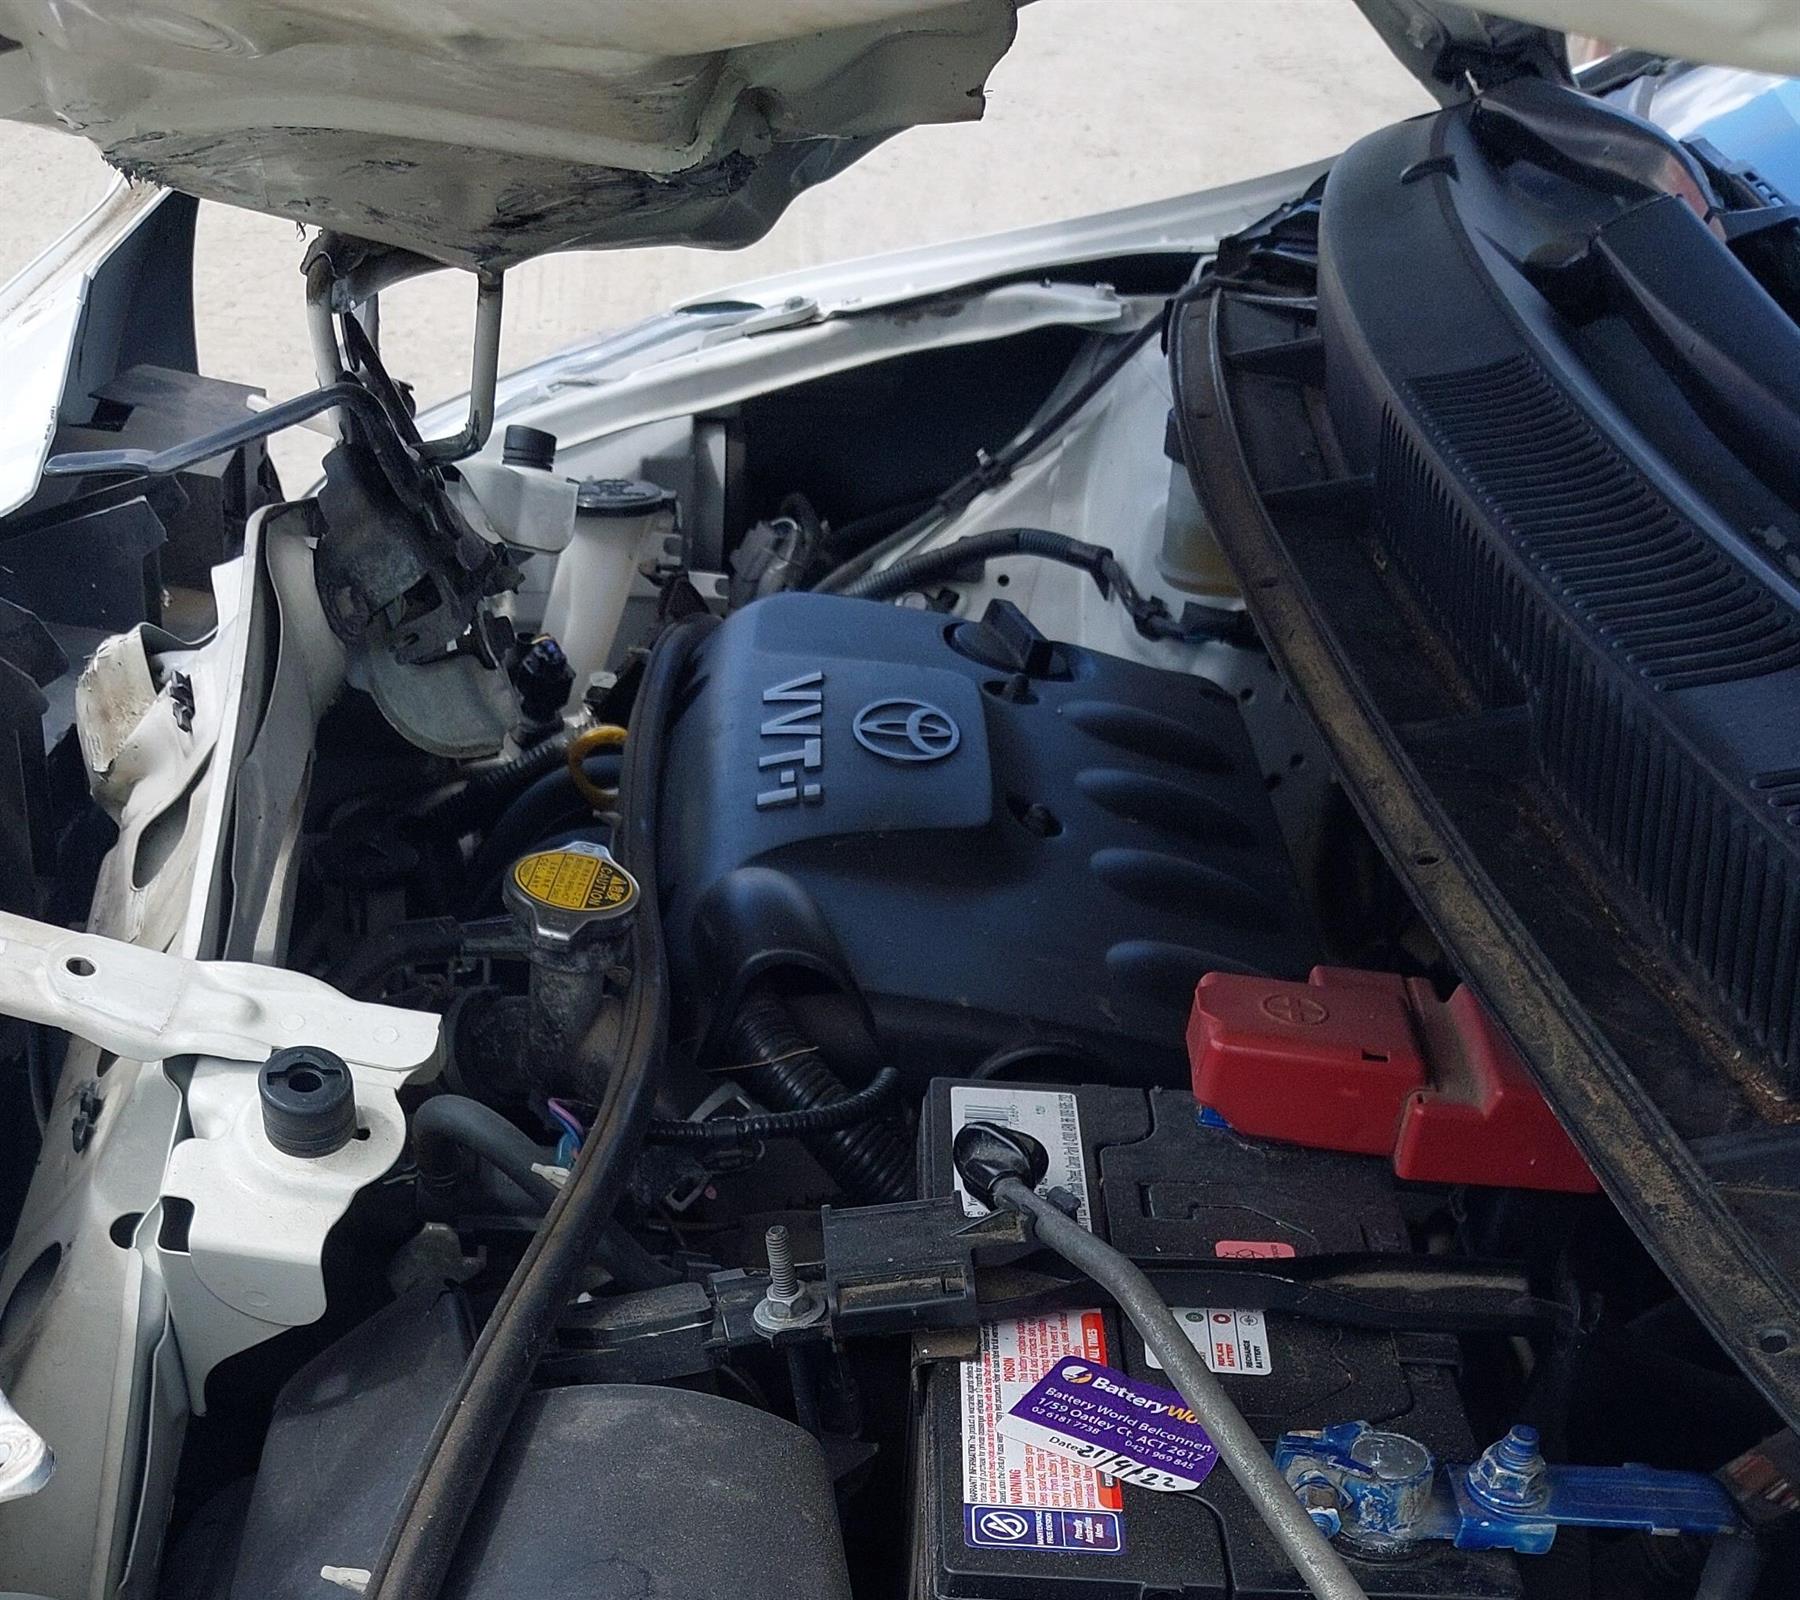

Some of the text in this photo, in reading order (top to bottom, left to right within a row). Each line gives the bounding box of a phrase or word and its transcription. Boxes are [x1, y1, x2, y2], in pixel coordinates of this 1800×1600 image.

[755, 670, 823, 810] VVT-i
[587, 866, 614, 907] CAUTION
[1087, 1329, 1099, 1347] TIMES
[1089, 1348, 1100, 1358] ALL
[1216, 1343, 1226, 1367] REPLACE
[1226, 1343, 1235, 1367] BATTERY
[1243, 1340, 1253, 1368] RECHARGE
[1253, 1345, 1263, 1369] BATTERY
[1003, 1358, 1016, 1382] POISON
[1091, 1376, 1201, 1425] BatteryWo
[1031, 1406, 1045, 1415] 02
[1046, 1411, 1071, 1425] 6181
[1045, 1388, 1213, 1453] Battery World Belconnen
[1037, 1397, 1069, 1413] 1/59
[1072, 1407, 1115, 1430] Oatley
[1136, 1434, 1166, 1450] ACT
[1169, 1443, 1205, 1461] 2617
[968, 1444, 977, 1474] INFORMATION
[1036, 1454, 1046, 1471] flames
[1125, 1439, 1194, 1470] 0421 969 845
[1024, 1456, 1034, 1478] batteries
[1070, 1465, 1081, 1479] Avoid
[969, 1476, 977, 1502] WARRANTY
[1010, 1469, 1022, 1504] WARNING
[1025, 1480, 1035, 1491] acid
[1050, 1478, 1059, 1491] from
[1025, 1492, 1036, 1505] Lead
[1039, 1493, 1048, 1506] Keep
[1052, 1493, 1060, 1507] away
[1062, 1488, 1072, 1507] battery
[1036, 1511, 1045, 1545] MAINTENANCE
[1044, 1512, 1054, 1544] FREE DESIGN
[1074, 1519, 1084, 1540] Proudly
[1084, 1516, 1094, 1544] Australian
[1094, 1523, 1104, 1538] Made
